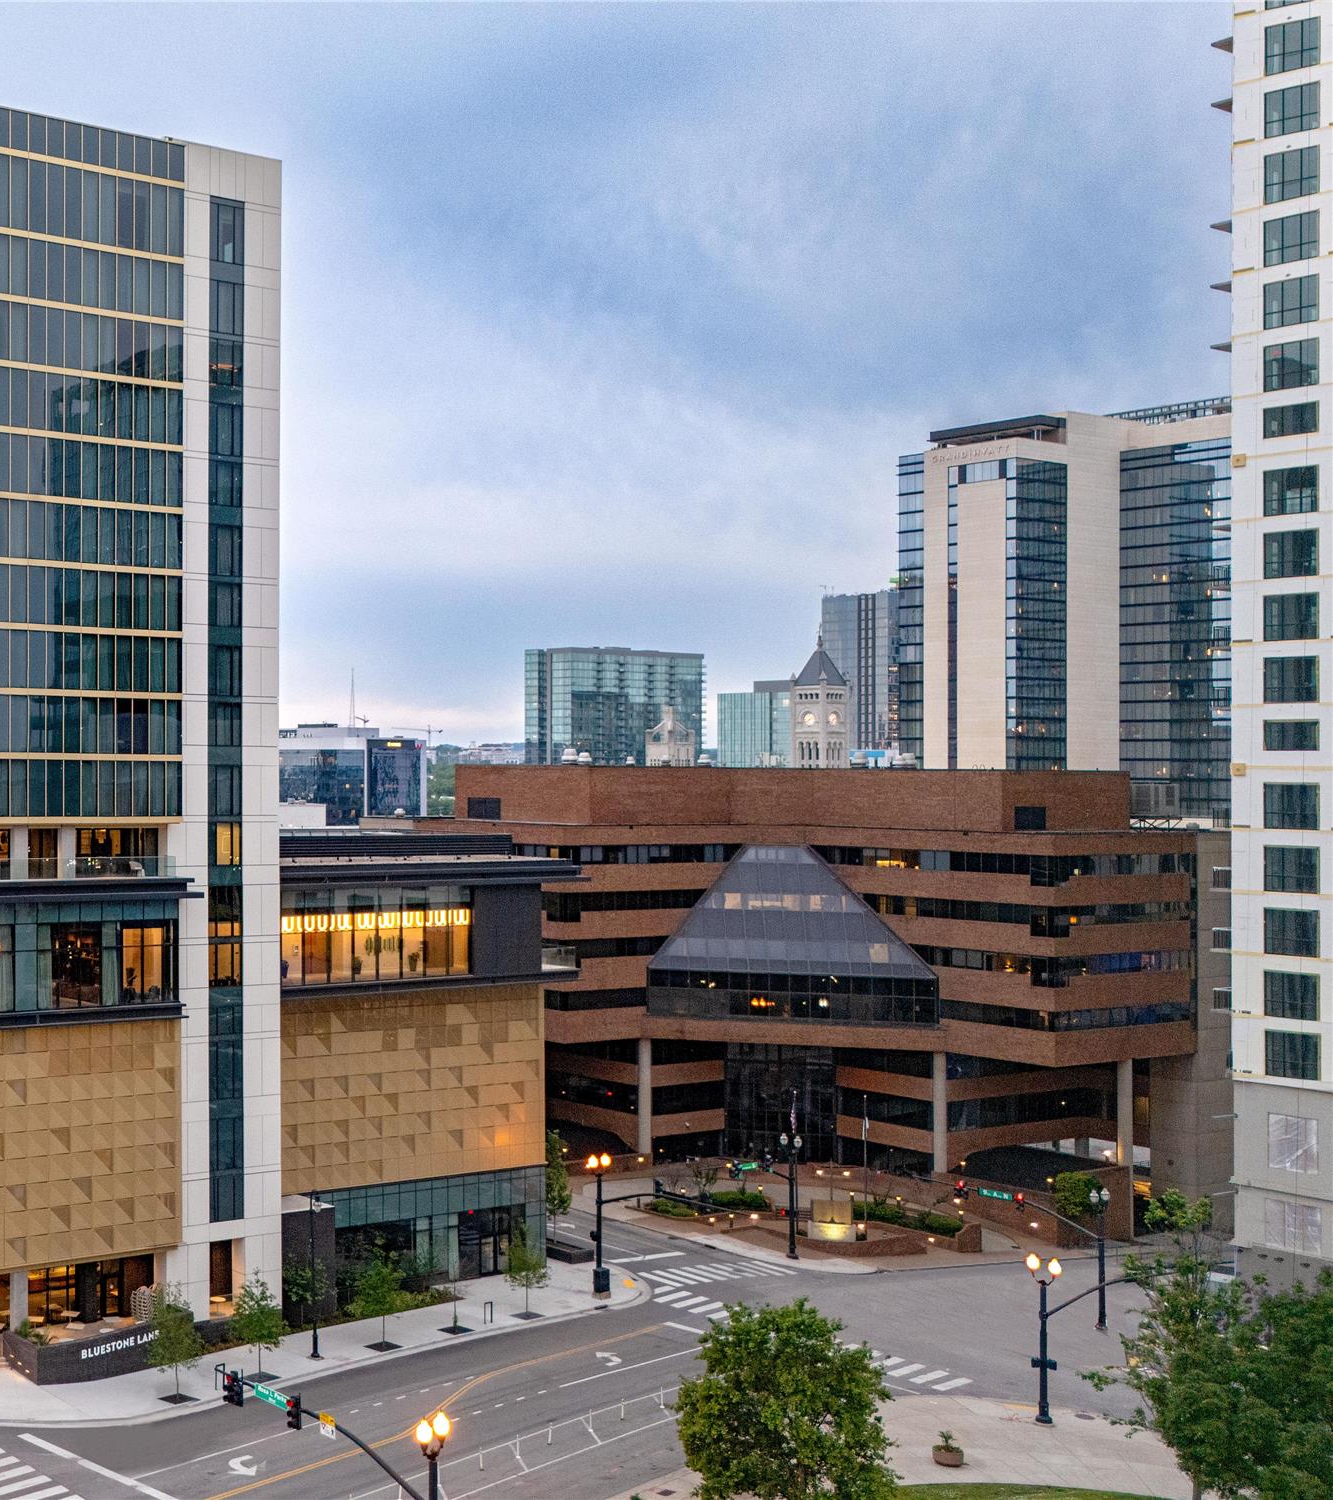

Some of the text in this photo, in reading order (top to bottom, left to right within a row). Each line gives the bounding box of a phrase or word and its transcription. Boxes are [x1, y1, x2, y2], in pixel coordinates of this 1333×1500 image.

[931, 450, 968, 463] GRAND
[81, 1336, 136, 1359] BLUESTONE
[257, 1385, 269, 1395] Rosa
